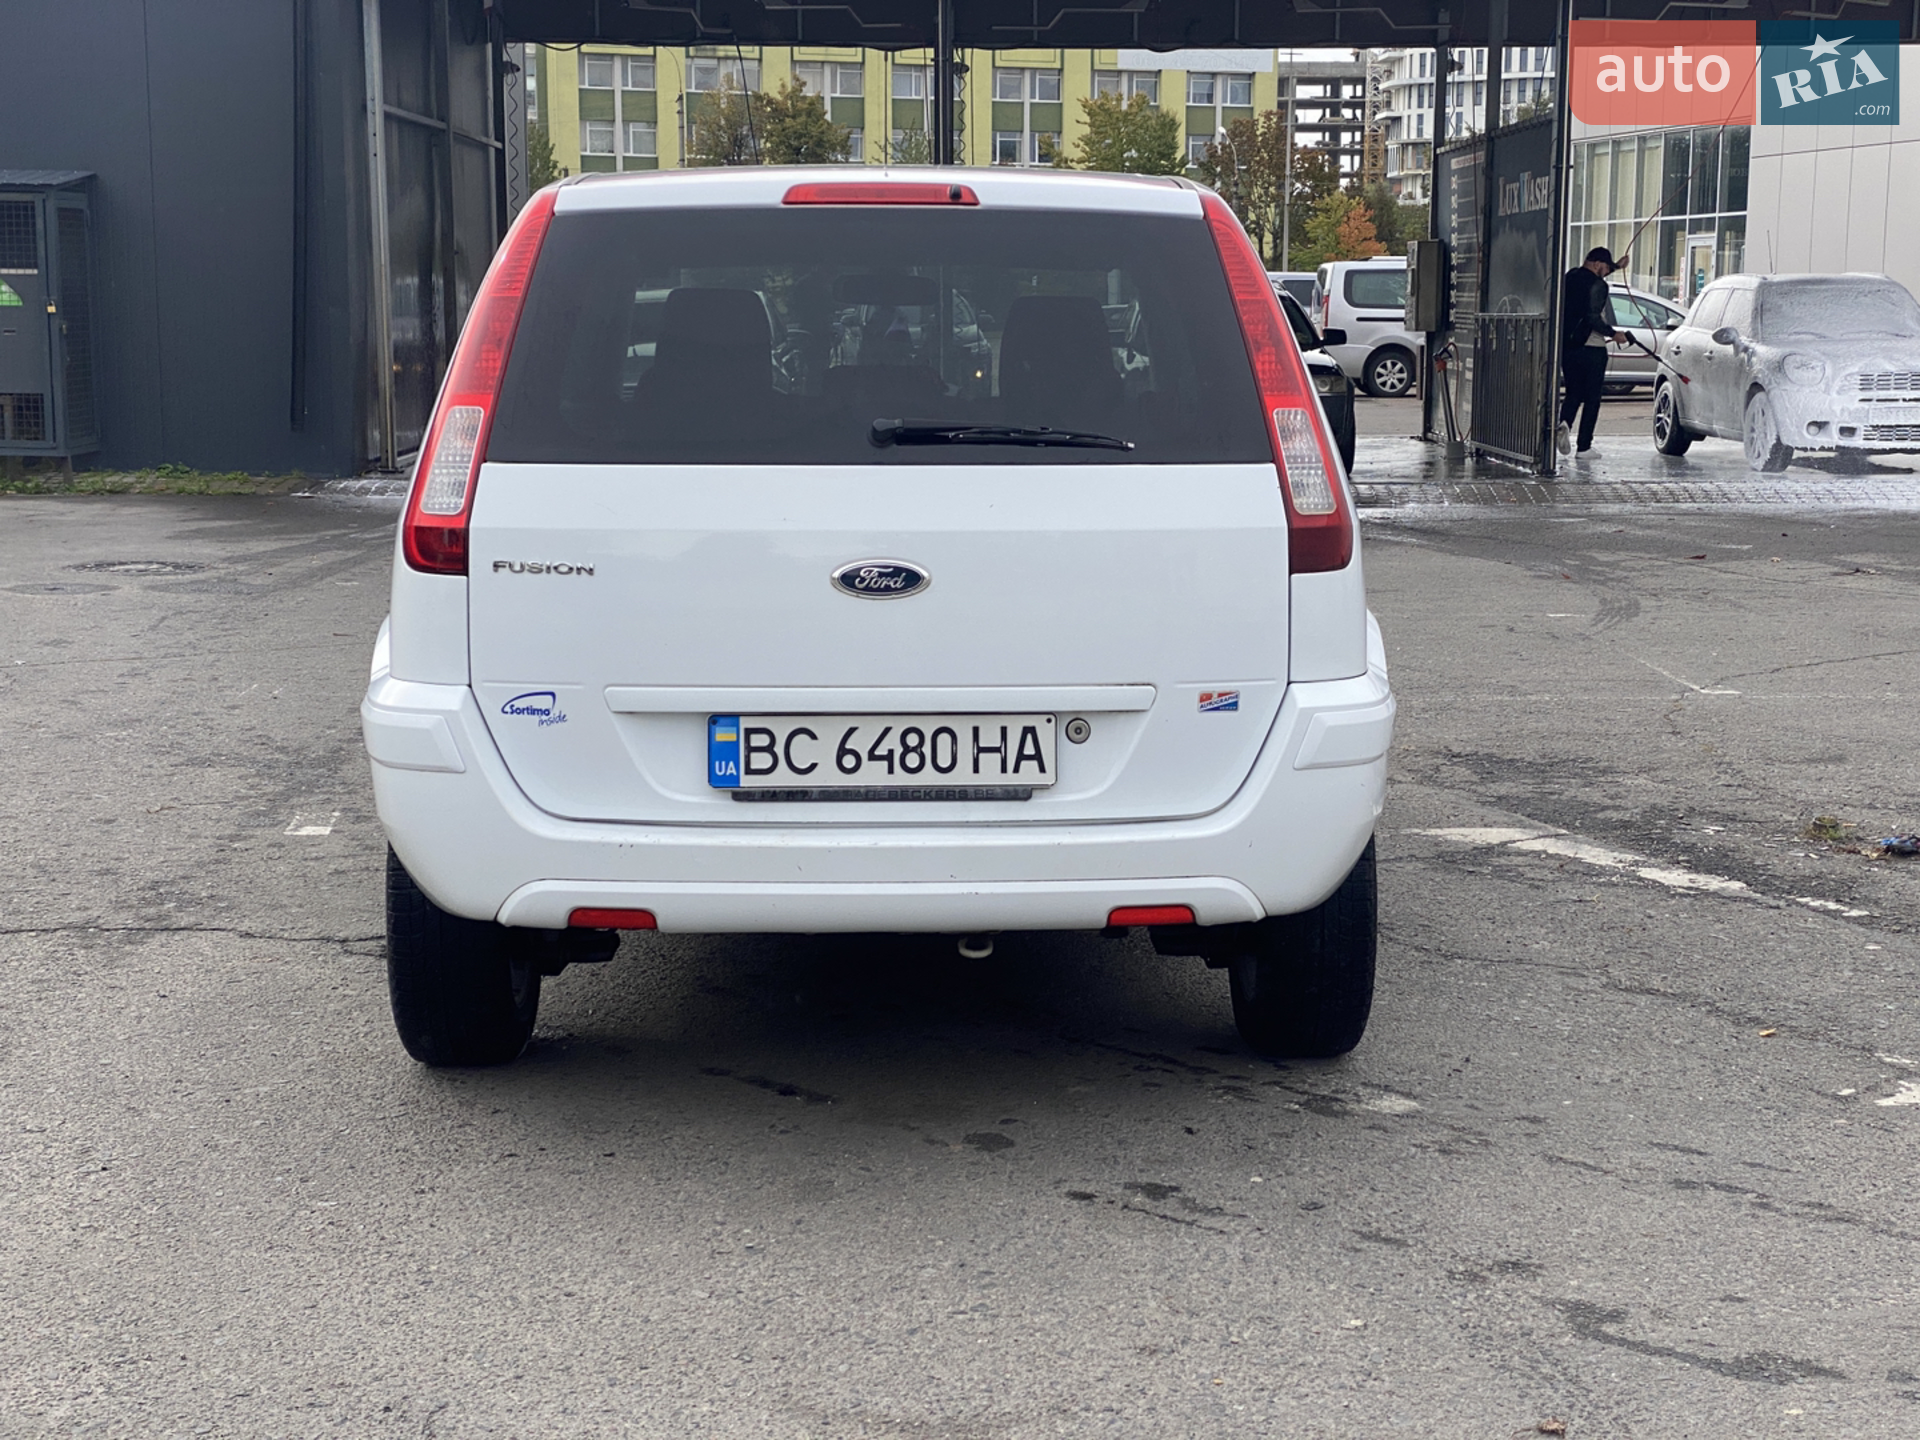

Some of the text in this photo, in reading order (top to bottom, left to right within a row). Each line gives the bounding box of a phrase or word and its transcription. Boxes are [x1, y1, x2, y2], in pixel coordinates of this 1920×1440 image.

[493, 560, 595, 576] FUSION
[855, 567, 906, 588] Ford
[509, 704, 551, 717] Sortimo
[538, 711, 568, 728] inside
[744, 725, 1047, 775] BC 6480 HA
[715, 761, 737, 776] UA
